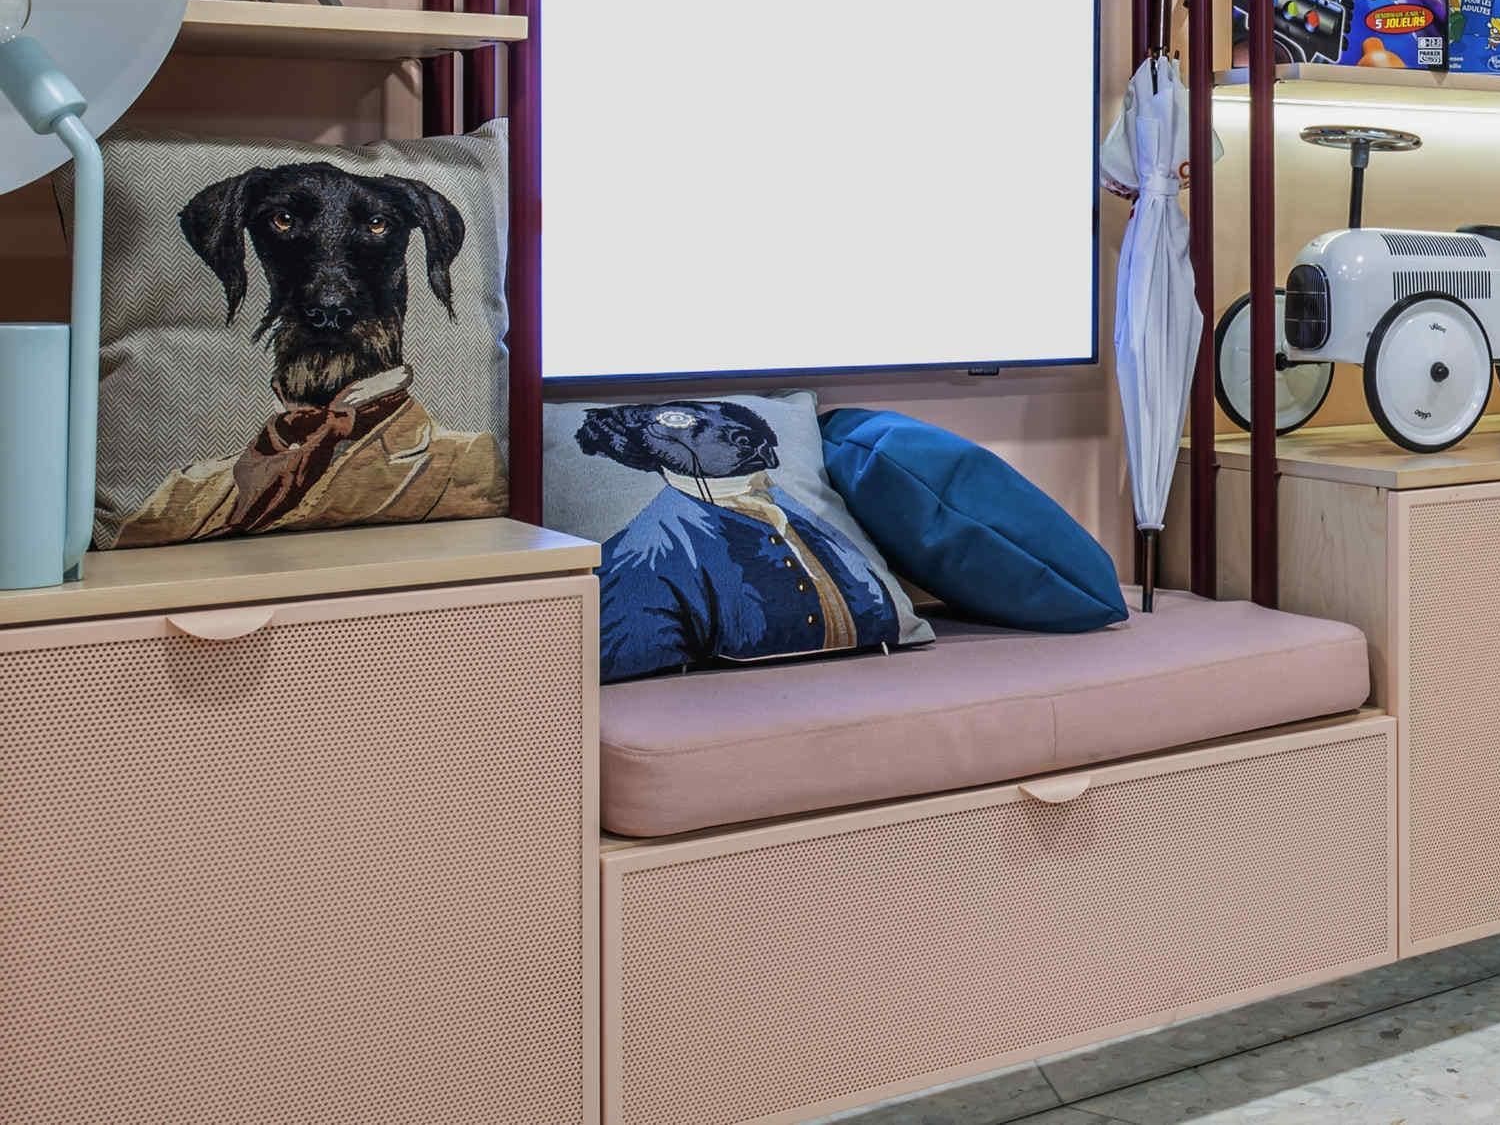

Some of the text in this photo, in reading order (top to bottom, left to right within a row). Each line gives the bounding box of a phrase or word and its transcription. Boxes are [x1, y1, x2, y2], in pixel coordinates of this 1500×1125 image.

[1481, 0, 1492, 7] LES
[1462, 5, 1491, 15] ADULTES
[1375, 16, 1426, 29] 5 JOUEURS
